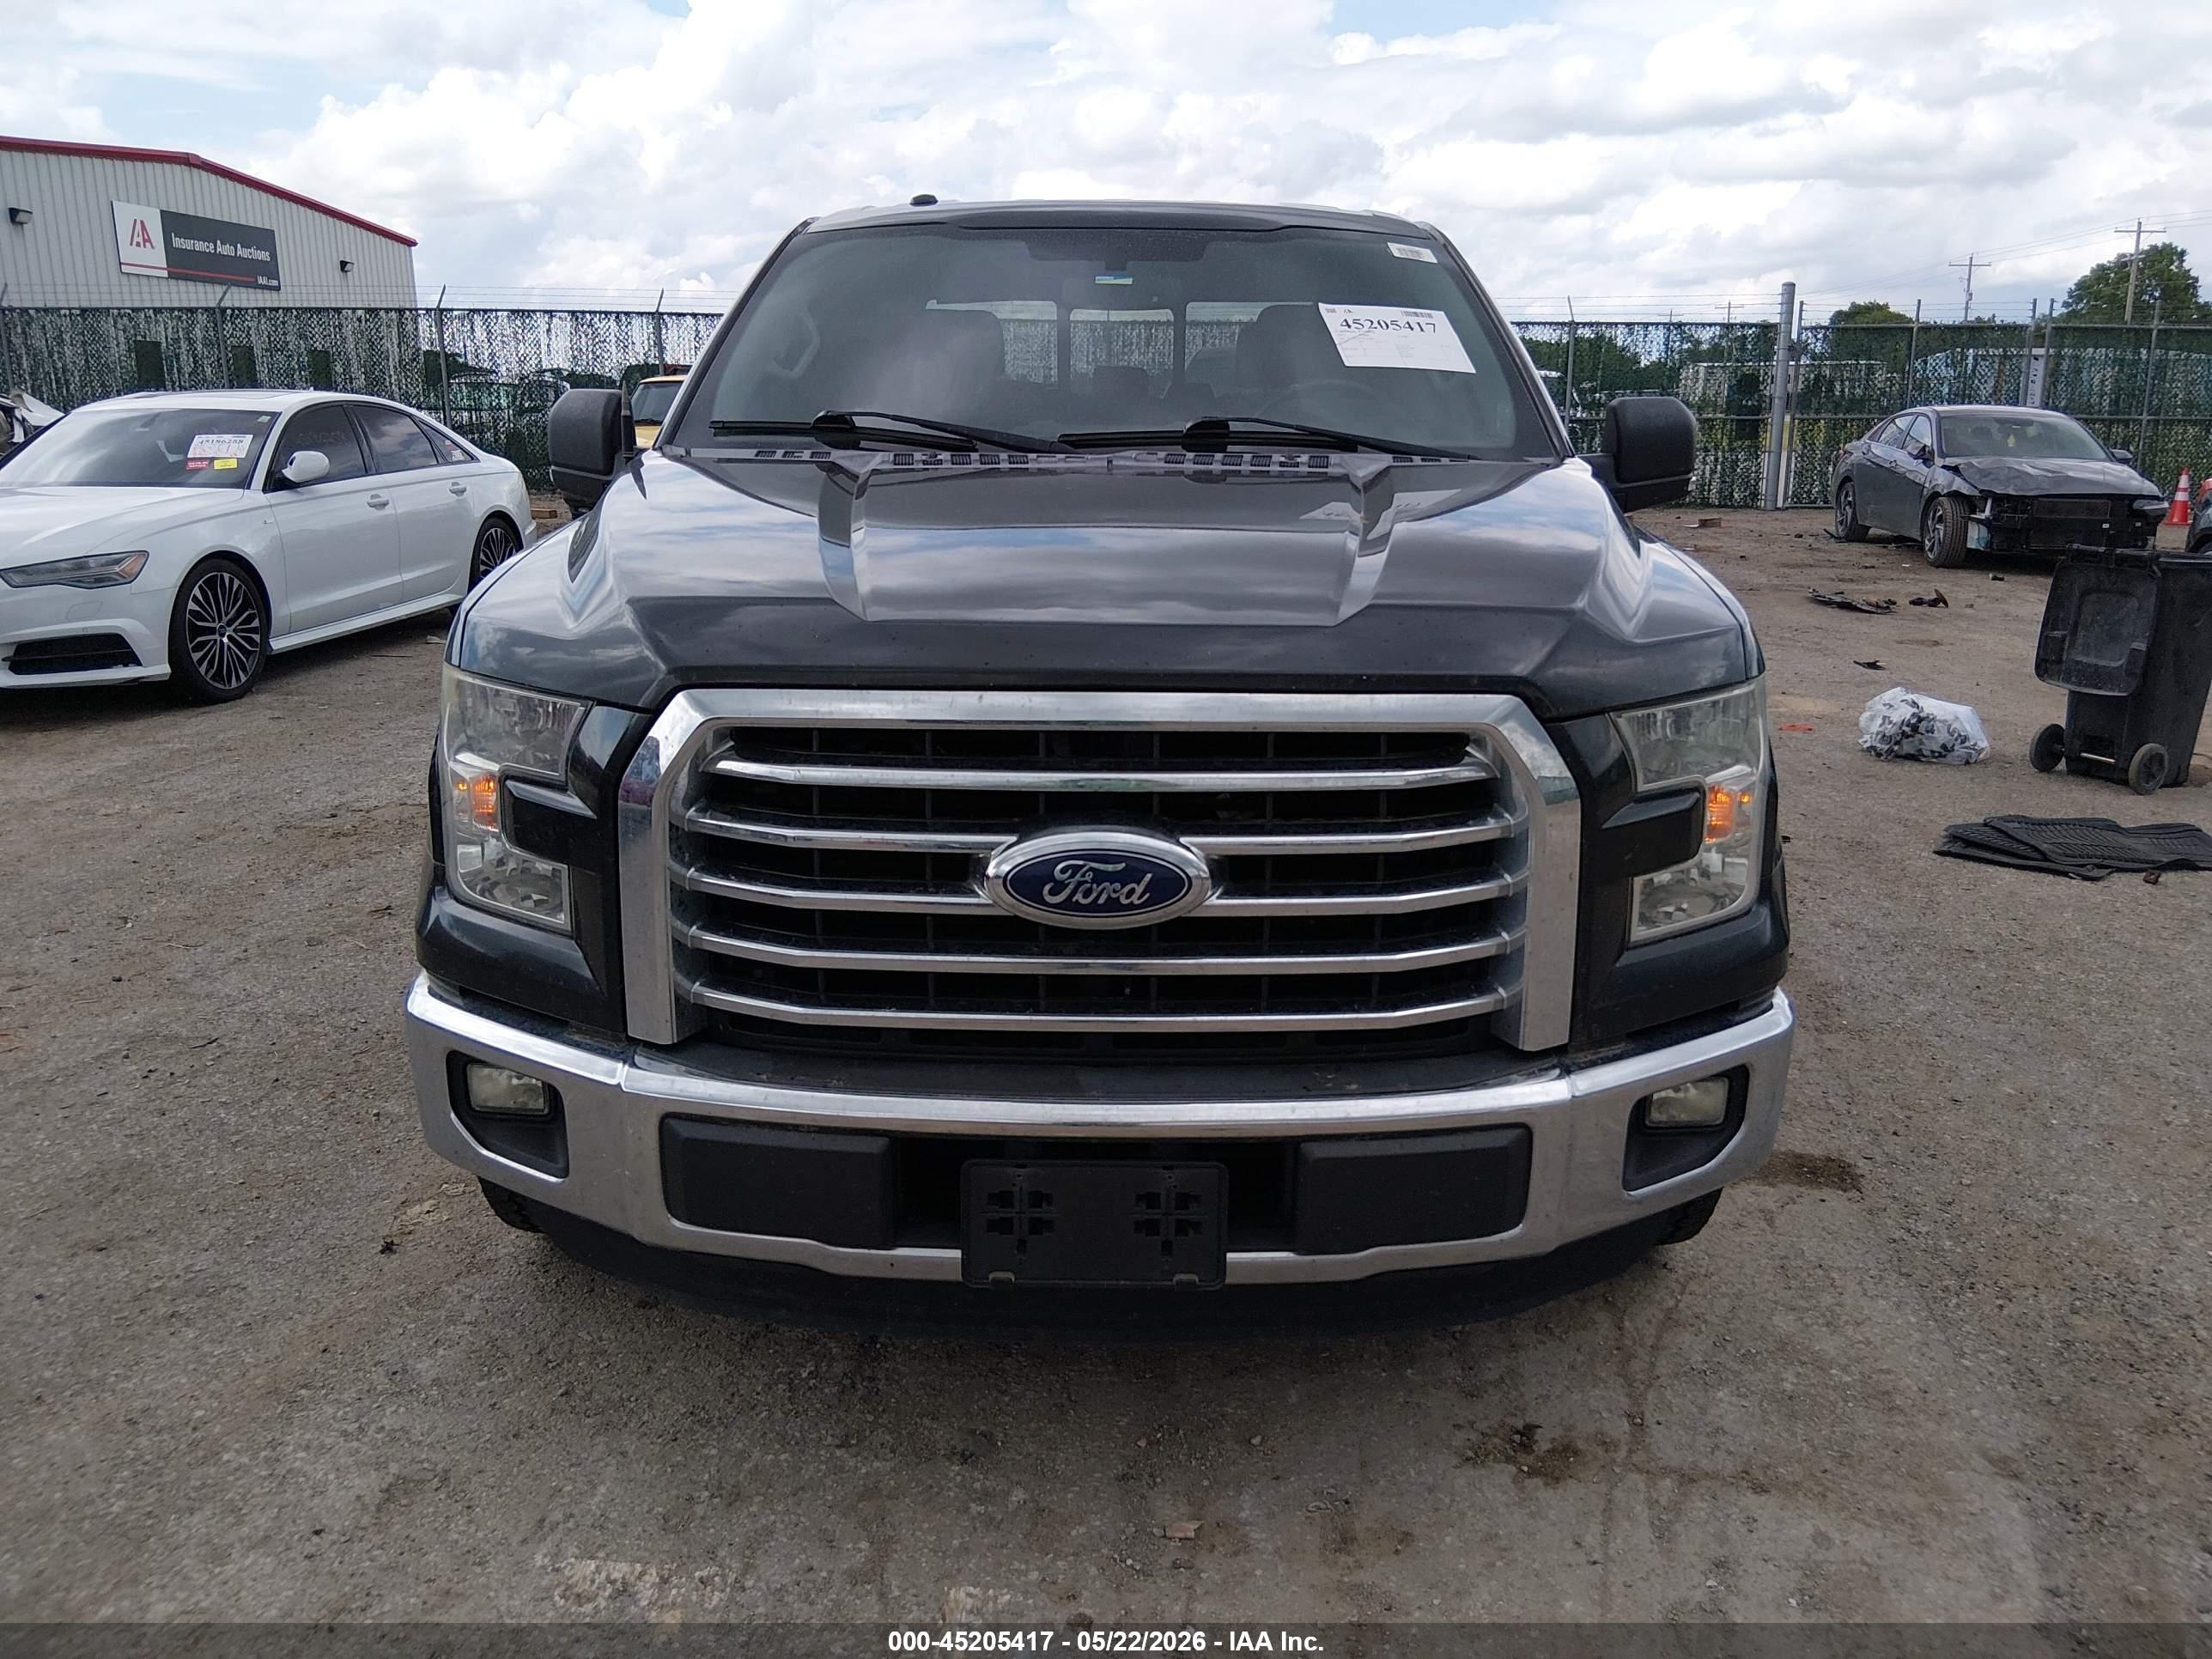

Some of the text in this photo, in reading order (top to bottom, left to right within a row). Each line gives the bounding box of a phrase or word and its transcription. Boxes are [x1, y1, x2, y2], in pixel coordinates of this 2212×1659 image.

[172, 232, 270, 262] Insurance Auto Auctions
[1340, 318, 1437, 334] 45205417
[1042, 860, 1153, 905] Ford
